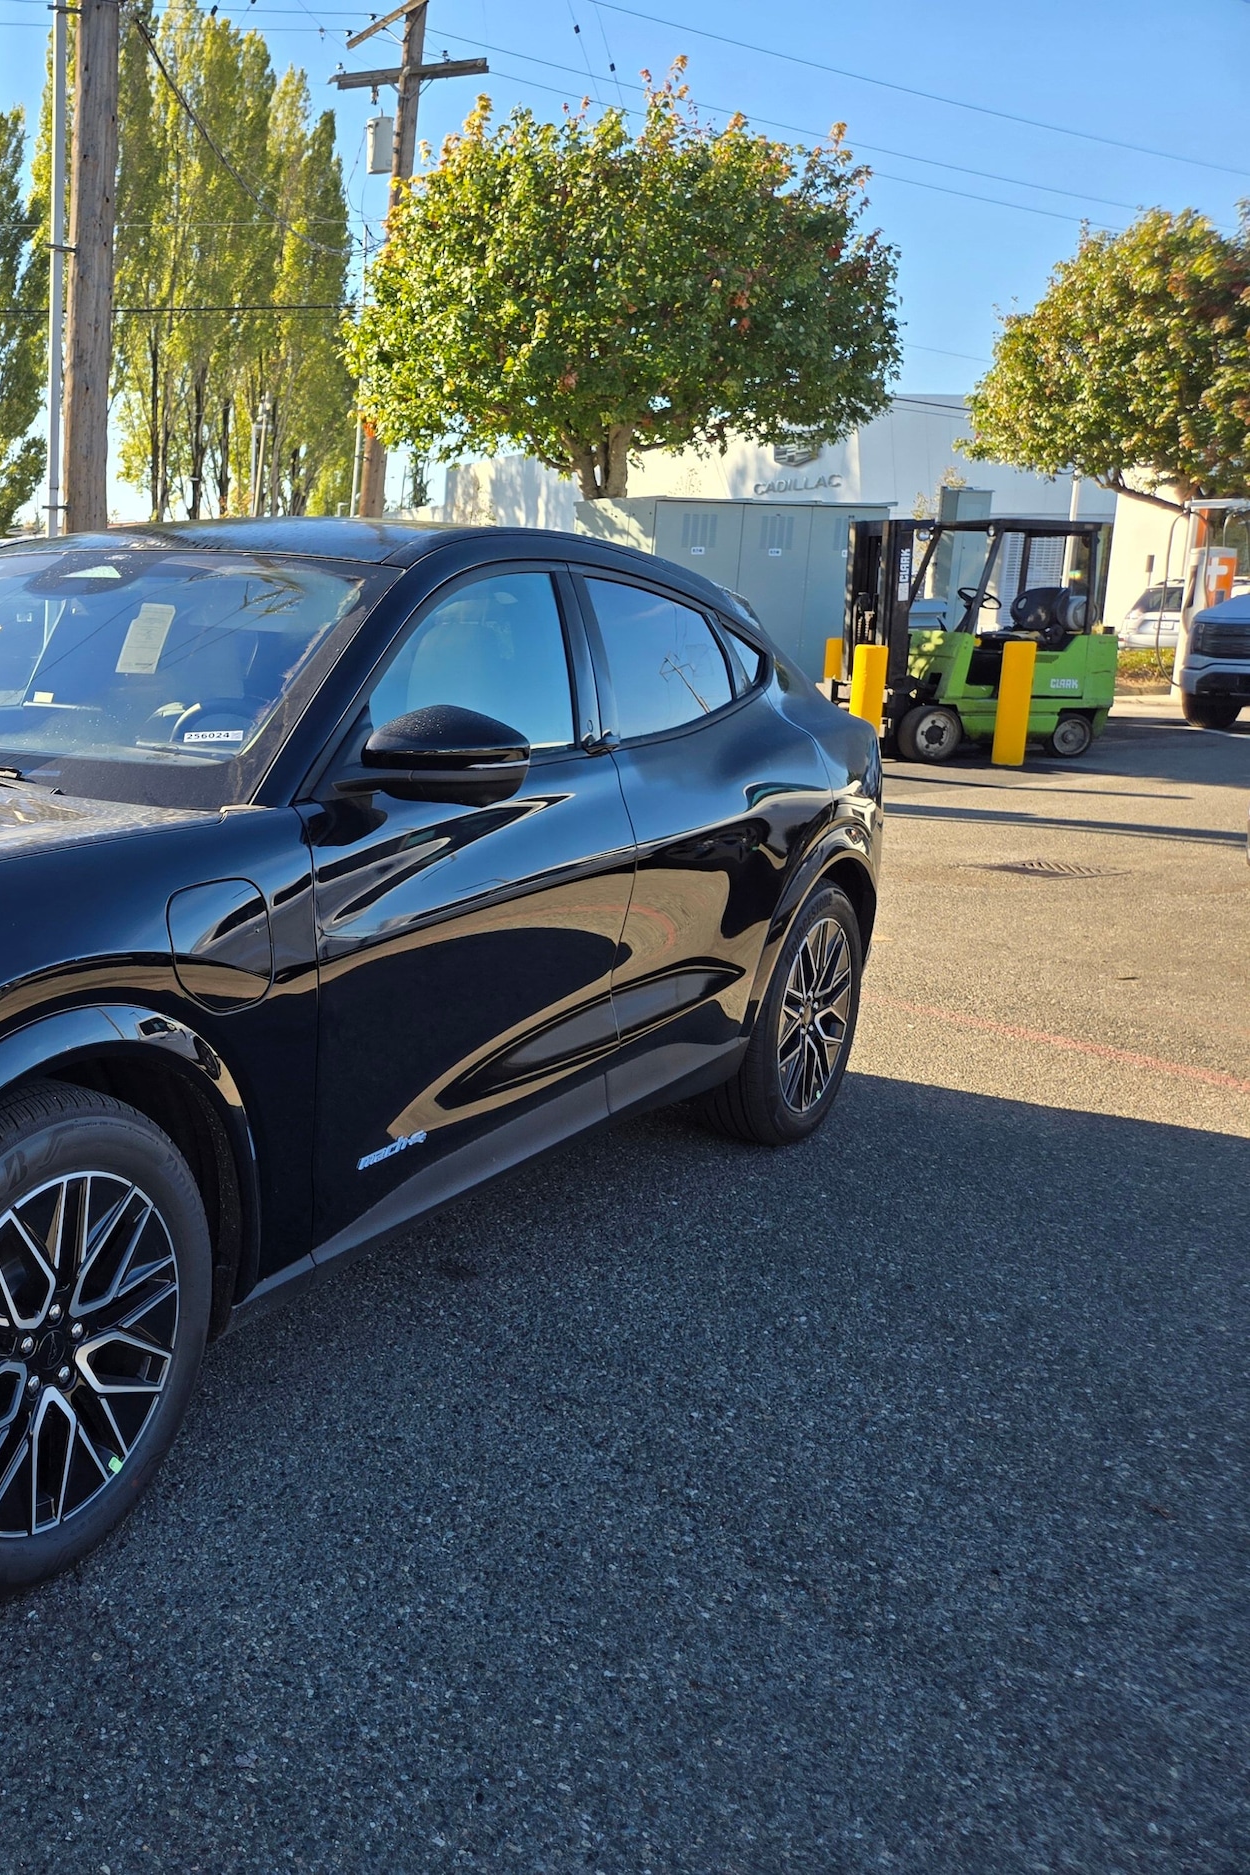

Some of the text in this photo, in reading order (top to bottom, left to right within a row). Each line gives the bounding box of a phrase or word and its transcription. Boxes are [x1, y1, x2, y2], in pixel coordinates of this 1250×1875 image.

[753, 474, 842, 495] CADILLAC
[899, 548, 910, 583] CLARK
[1050, 678, 1078, 689] CLARK
[186, 732, 230, 740] 256024
